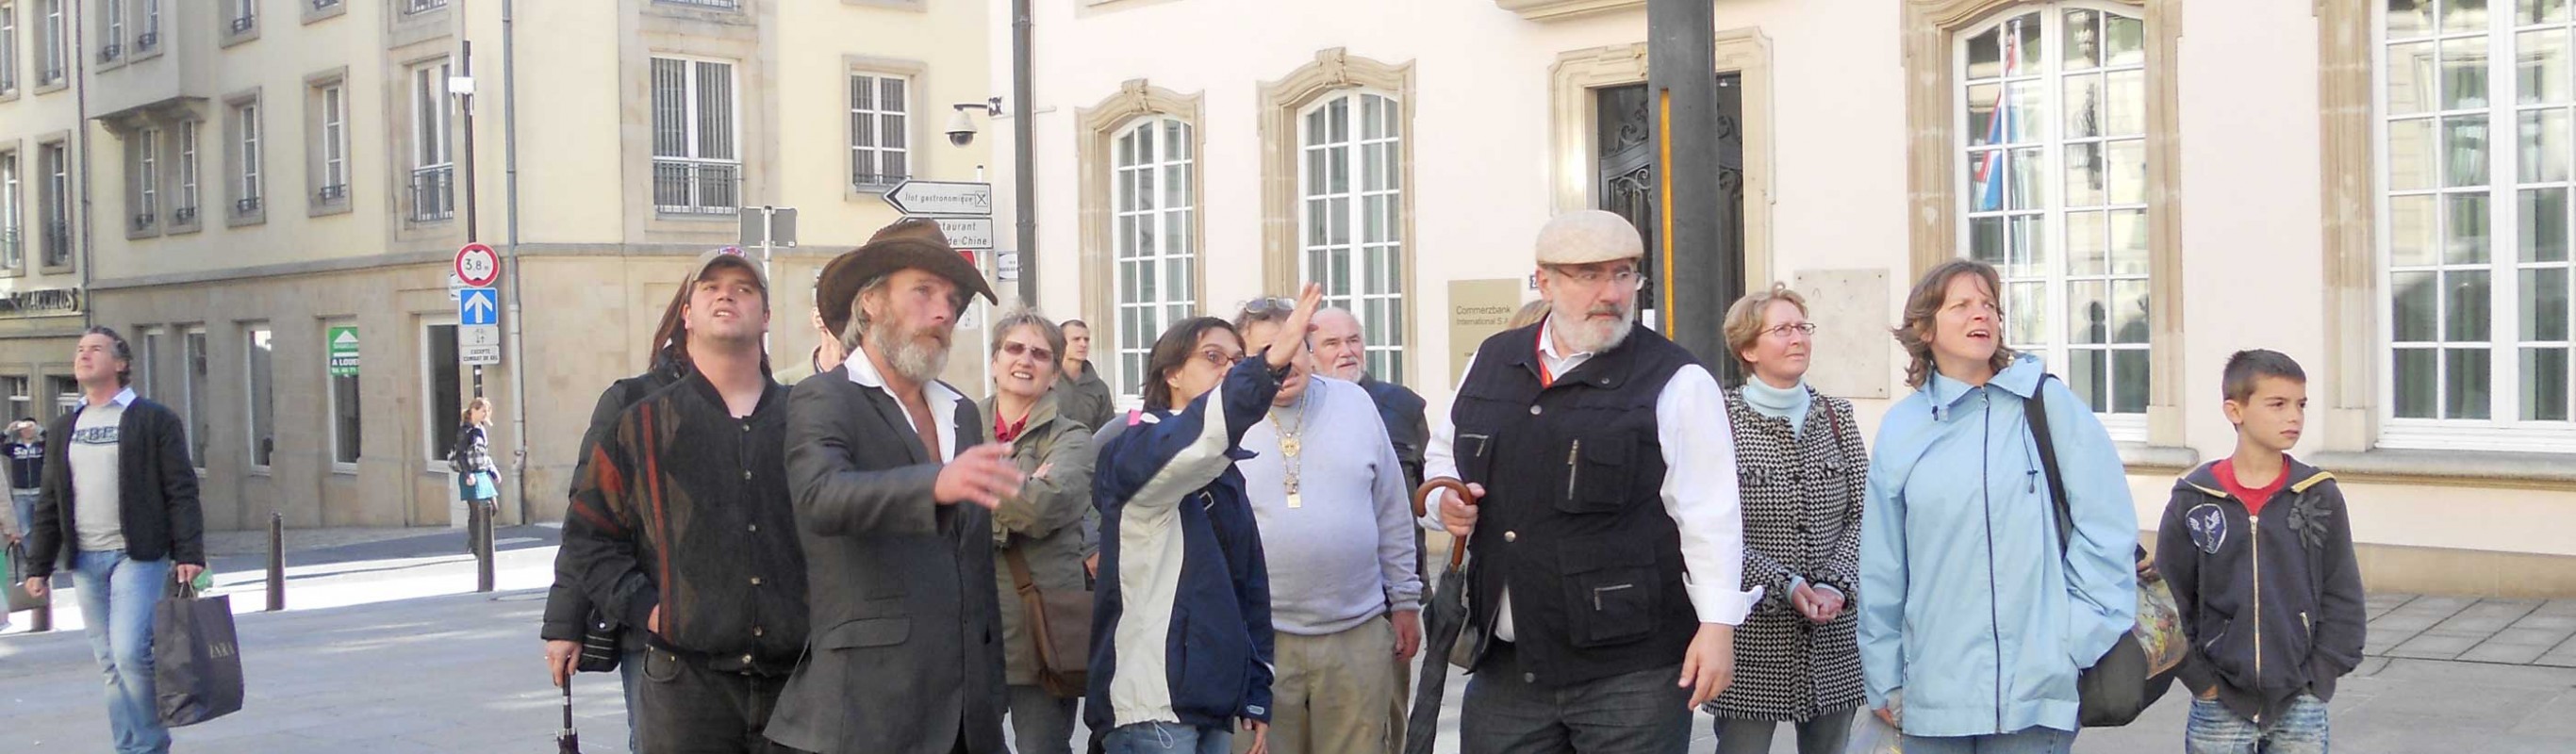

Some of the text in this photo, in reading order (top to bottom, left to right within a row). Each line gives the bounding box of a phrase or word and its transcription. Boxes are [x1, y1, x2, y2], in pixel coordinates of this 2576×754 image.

[920, 195, 973, 205] gastronomique
[942, 222, 976, 231] taurant
[1456, 304, 1511, 315] Commerzbank
